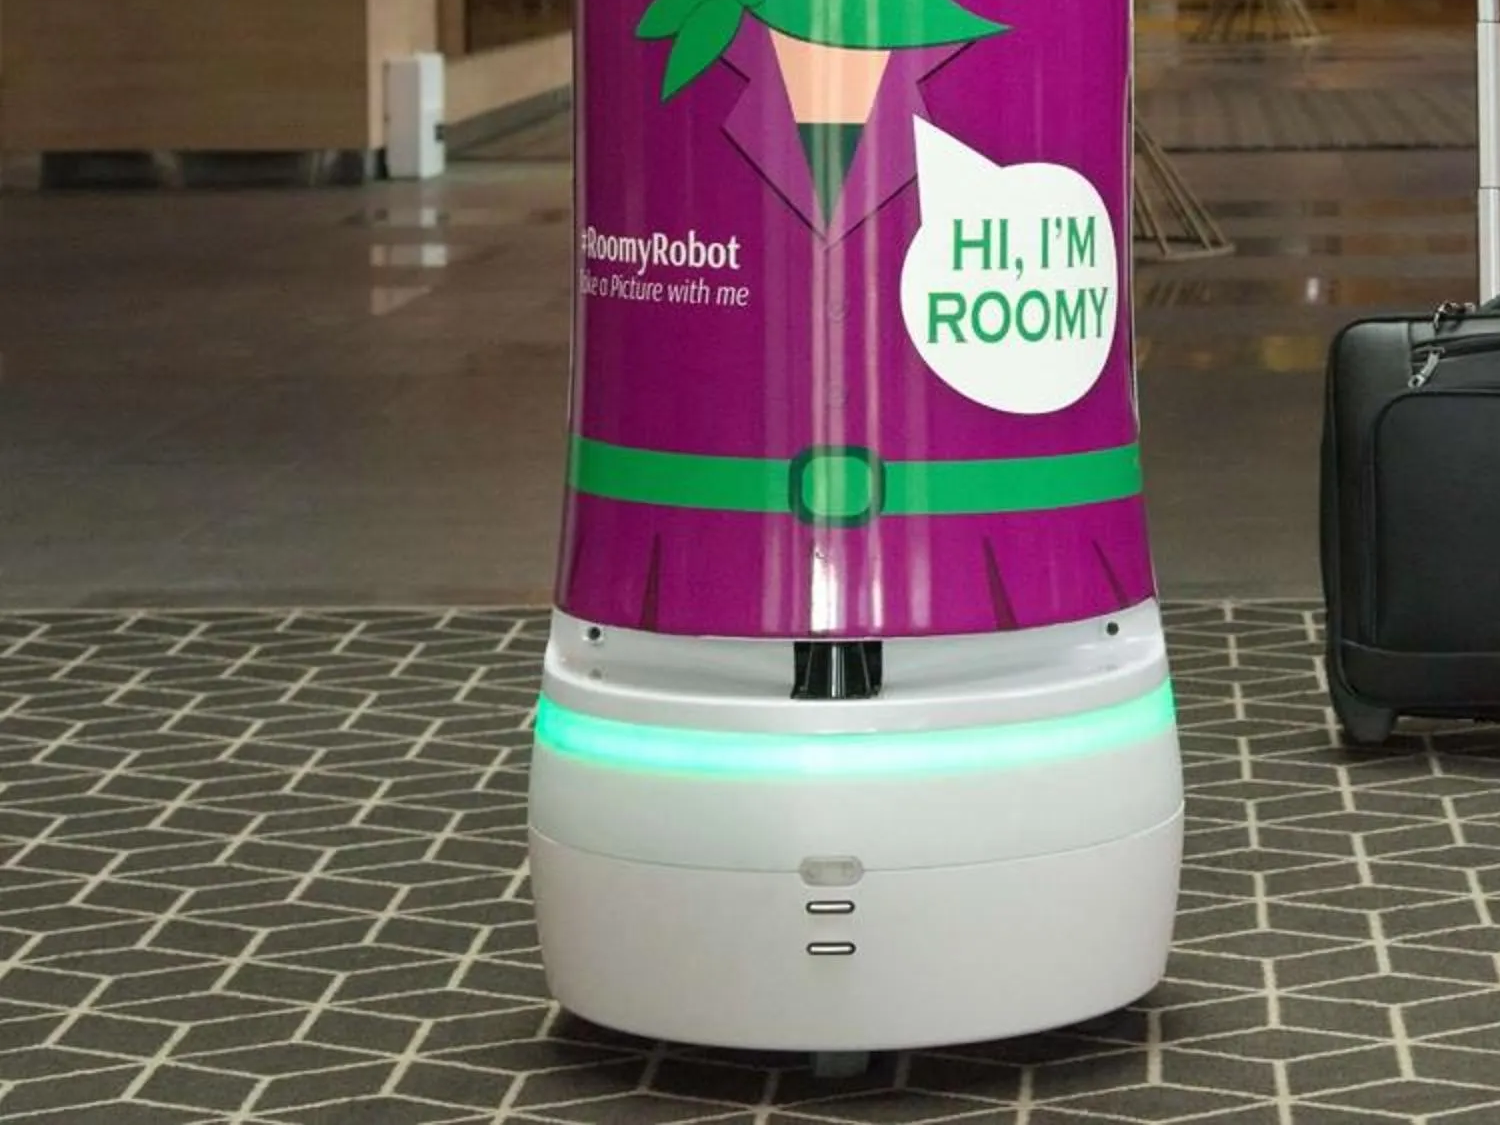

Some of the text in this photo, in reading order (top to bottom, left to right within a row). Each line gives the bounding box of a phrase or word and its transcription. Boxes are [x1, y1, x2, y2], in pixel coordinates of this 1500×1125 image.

[953, 216, 1096, 280] HI, I'M
[599, 277, 609, 296] a
[610, 274, 663, 302] Picture
[667, 277, 710, 306] with
[716, 286, 749, 307] me
[927, 287, 1109, 344] ROOMY
